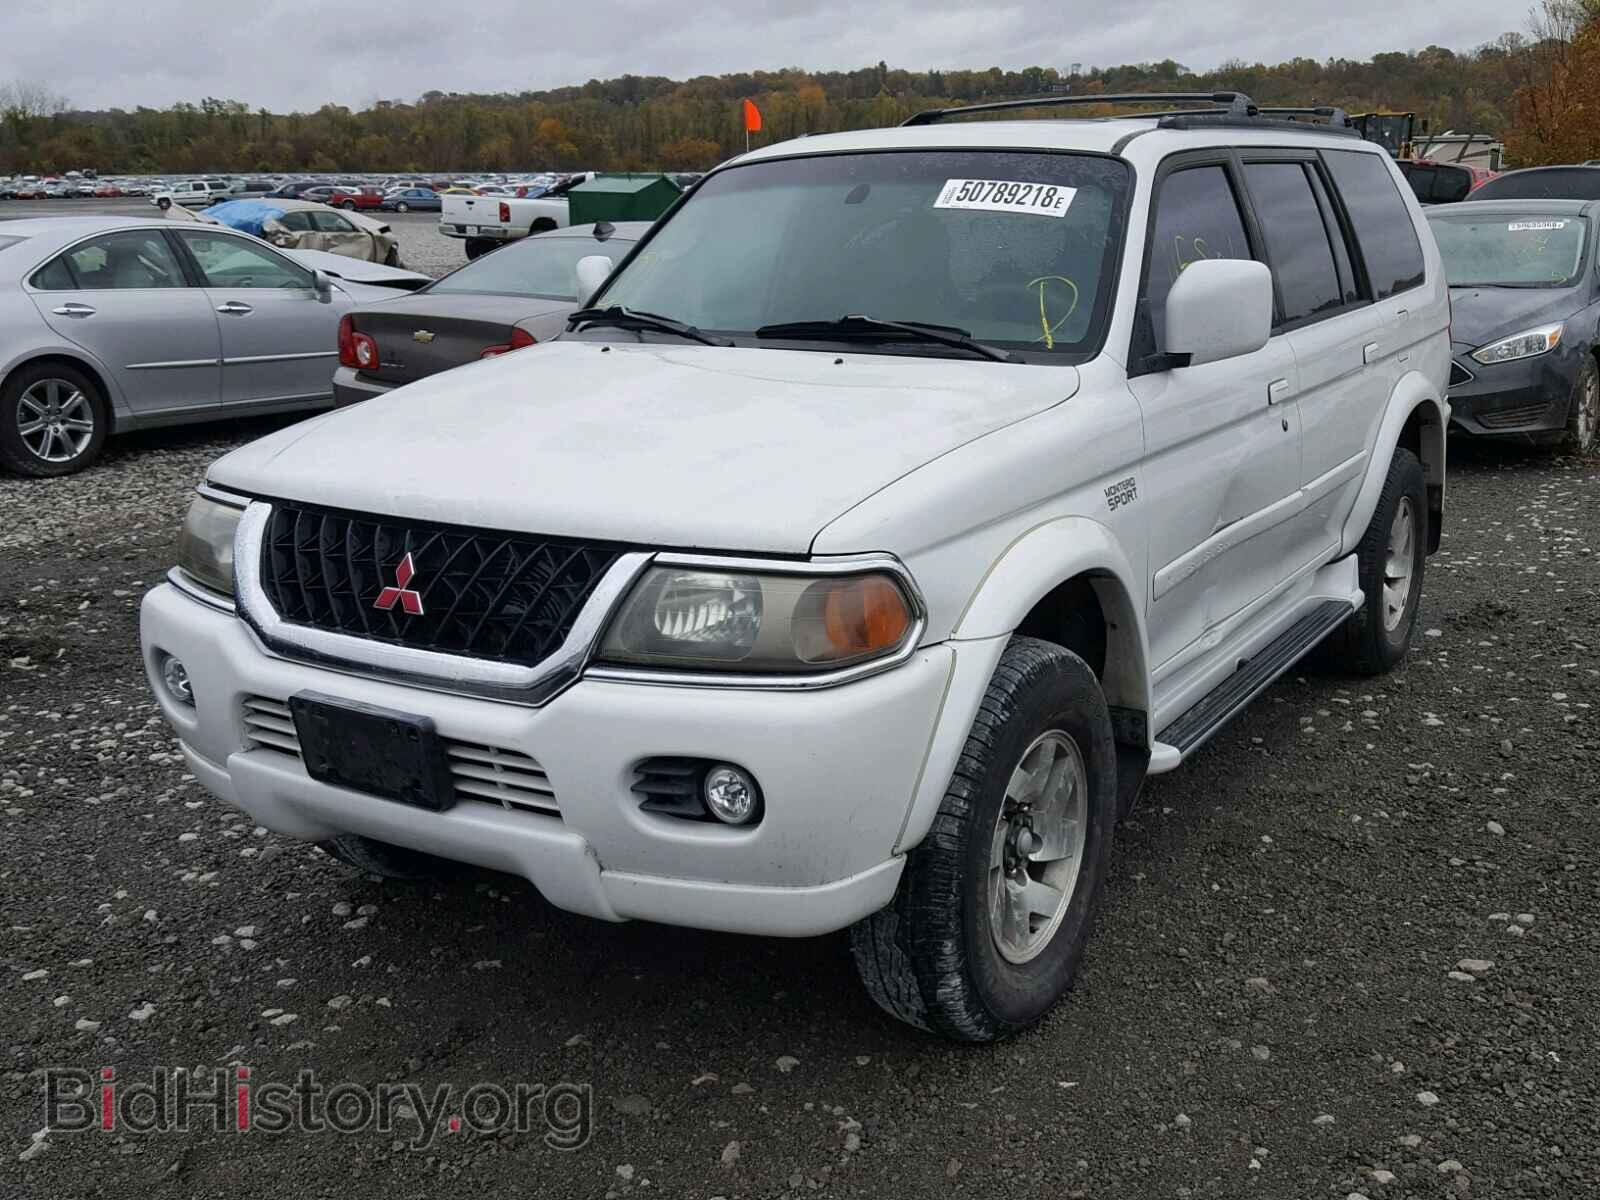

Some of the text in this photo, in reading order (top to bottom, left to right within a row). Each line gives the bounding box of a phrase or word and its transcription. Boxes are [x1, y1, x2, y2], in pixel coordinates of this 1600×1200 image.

[956, 181, 1058, 208] 50789218
[1104, 477, 1136, 497] MONTERO
[1107, 487, 1138, 511] SPORT
